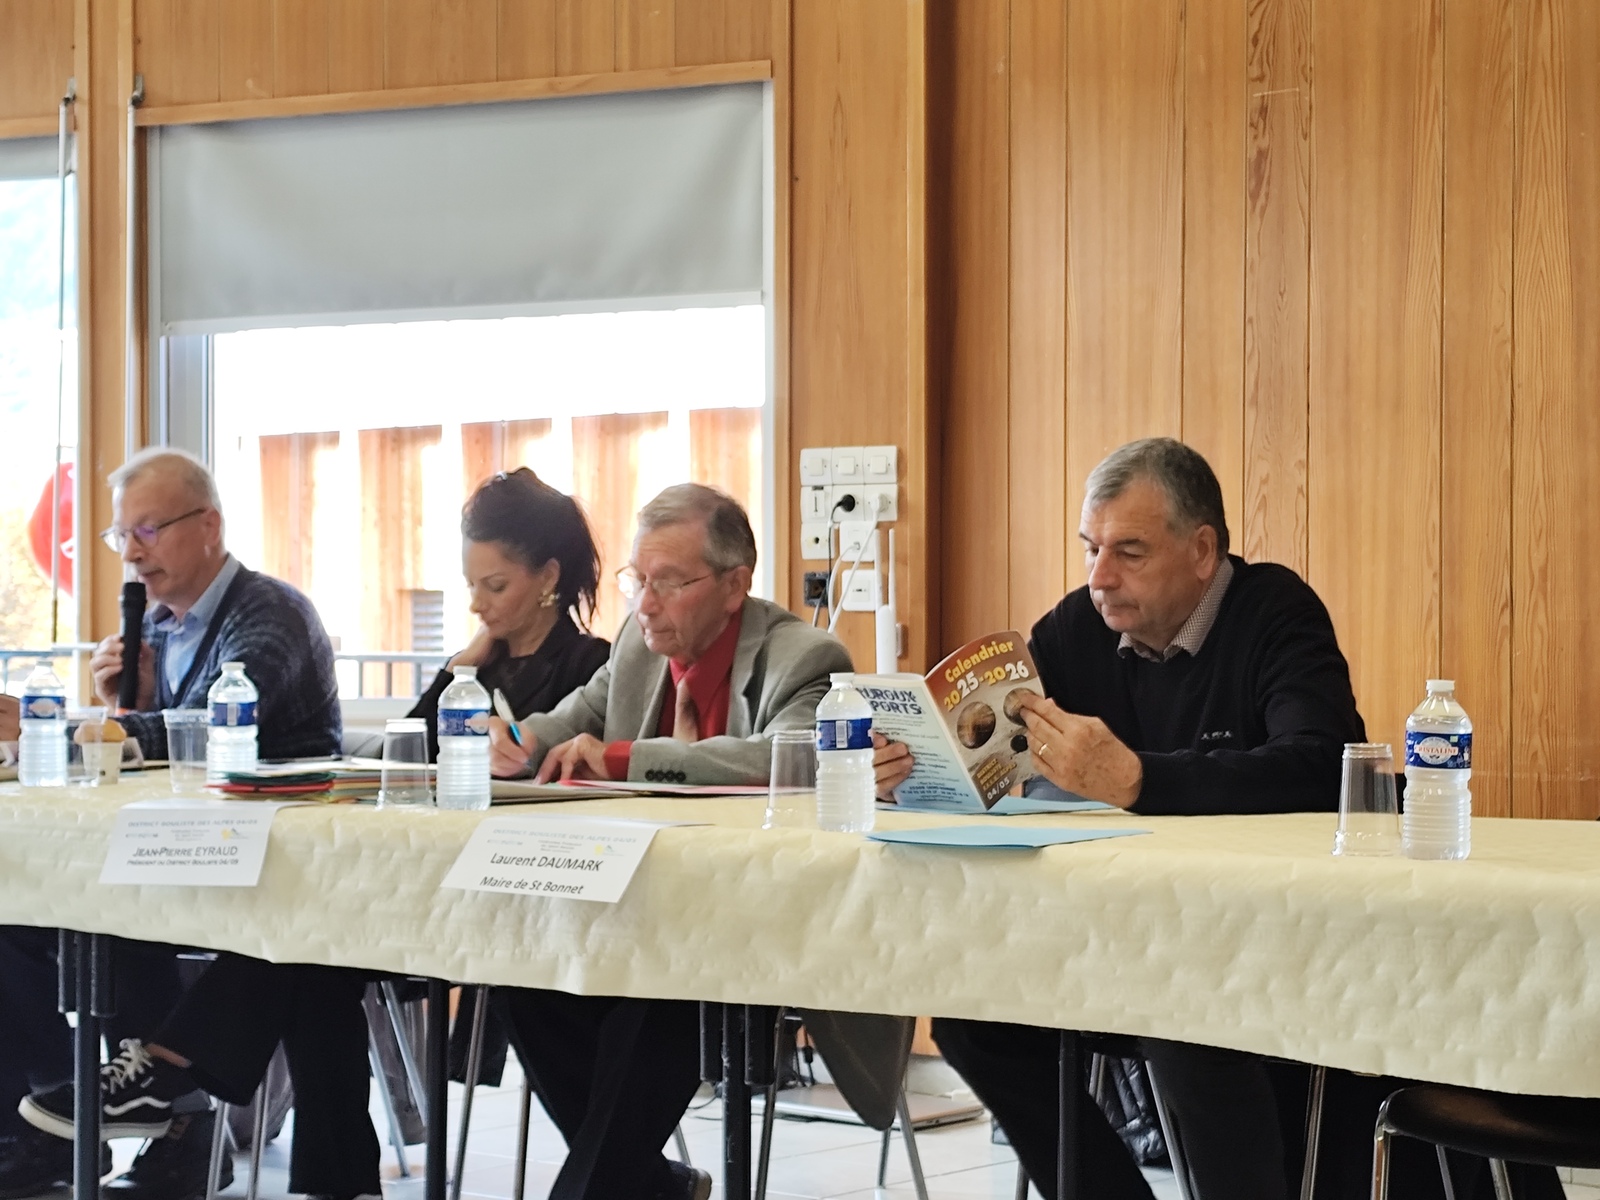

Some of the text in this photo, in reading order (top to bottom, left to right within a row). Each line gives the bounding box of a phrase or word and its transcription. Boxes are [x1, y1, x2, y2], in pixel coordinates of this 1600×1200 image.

[944, 640, 1014, 683] Calendrier
[855, 687, 918, 703] UROUX
[944, 660, 1029, 712] 2025-2026
[869, 700, 922, 715] PORTS
[987, 777, 1010, 800] 04/05
[195, 846, 238, 857] EYRAUD
[490, 853, 603, 871] Laurent DAUMARK
[479, 876, 584, 895] Maire de St Bonnet
